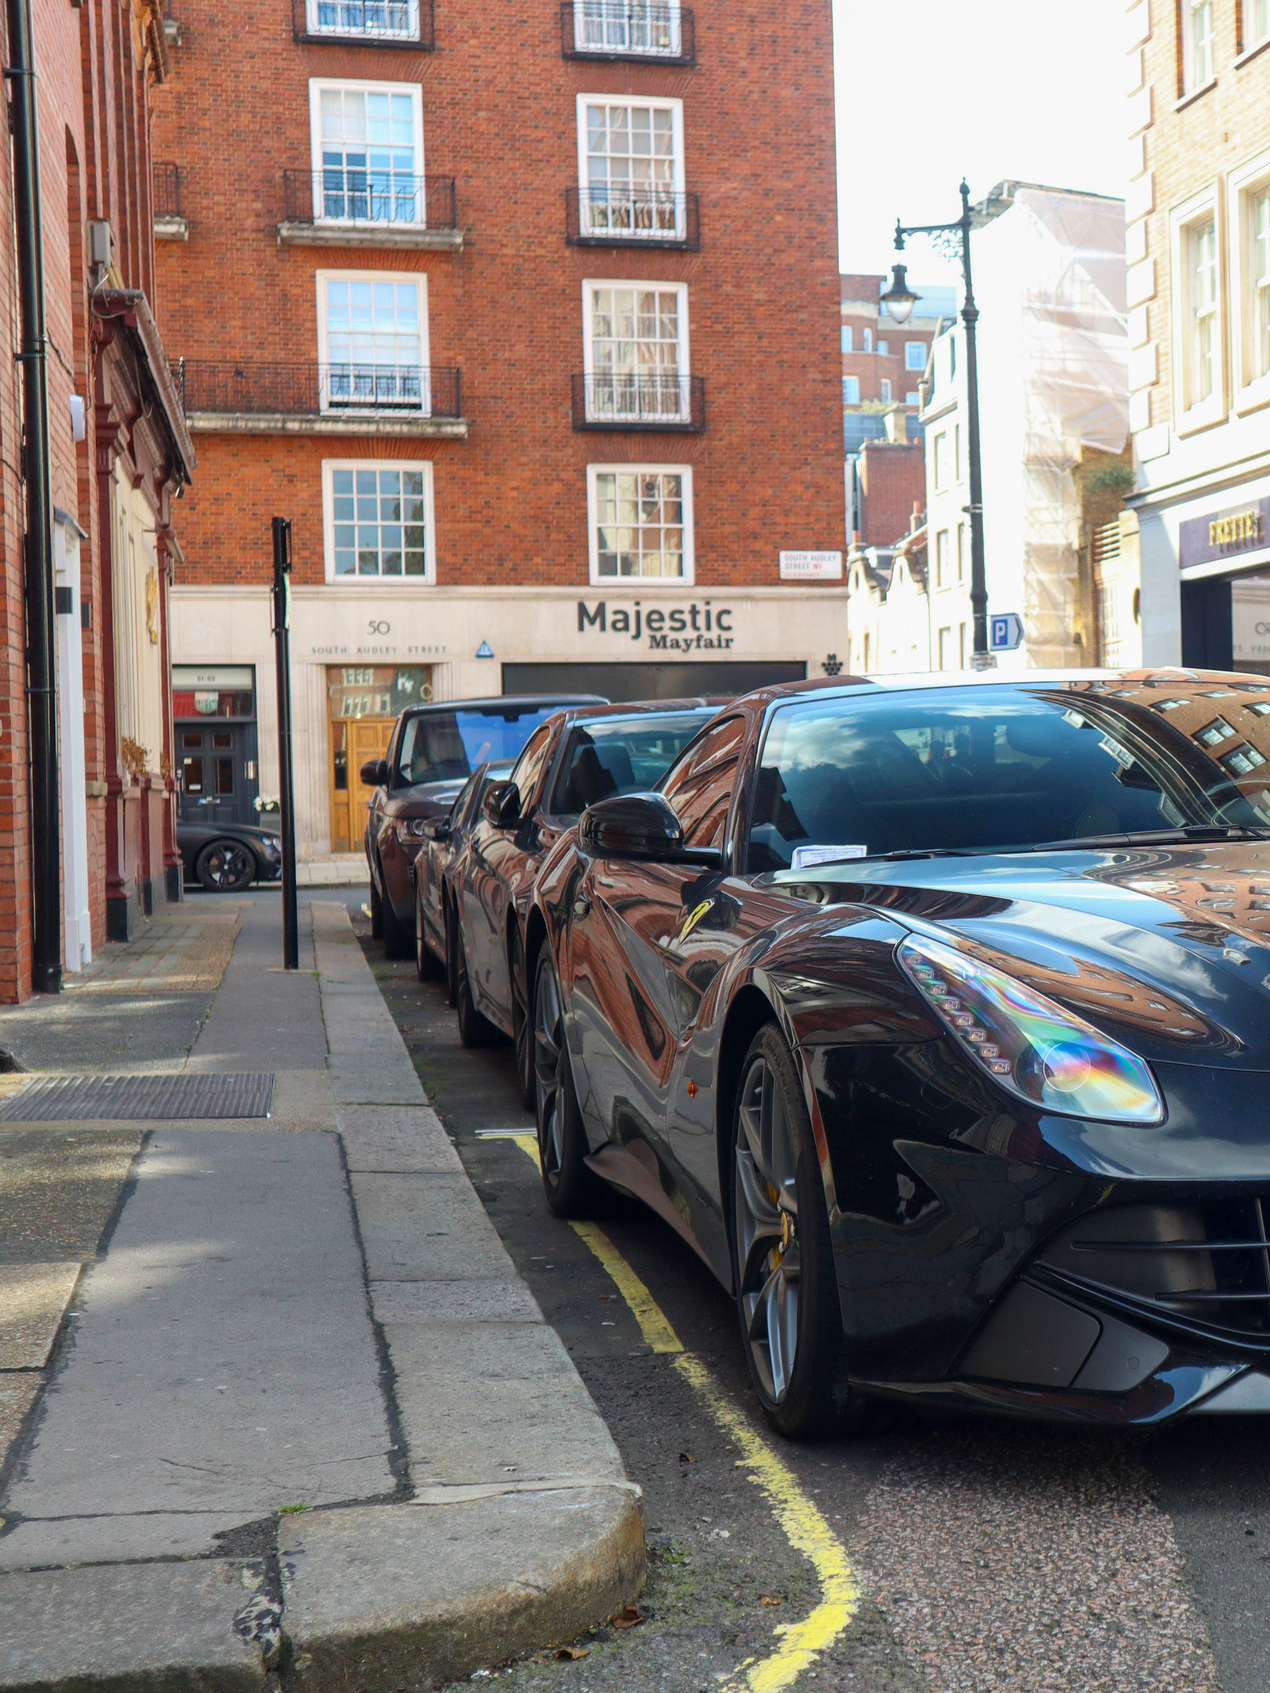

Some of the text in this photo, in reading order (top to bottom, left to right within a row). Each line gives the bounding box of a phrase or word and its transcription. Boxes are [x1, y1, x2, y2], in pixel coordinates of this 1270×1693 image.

[1208, 510, 1254, 546] FRETTE
[783, 554, 837, 562] SOUTH AUDLEY
[366, 620, 391, 635] 50
[577, 600, 733, 641] Majestic
[995, 621, 1006, 644] P
[312, 646, 447, 655] SOUTH AUDLEY STREET
[648, 634, 734, 653] Mayfair
